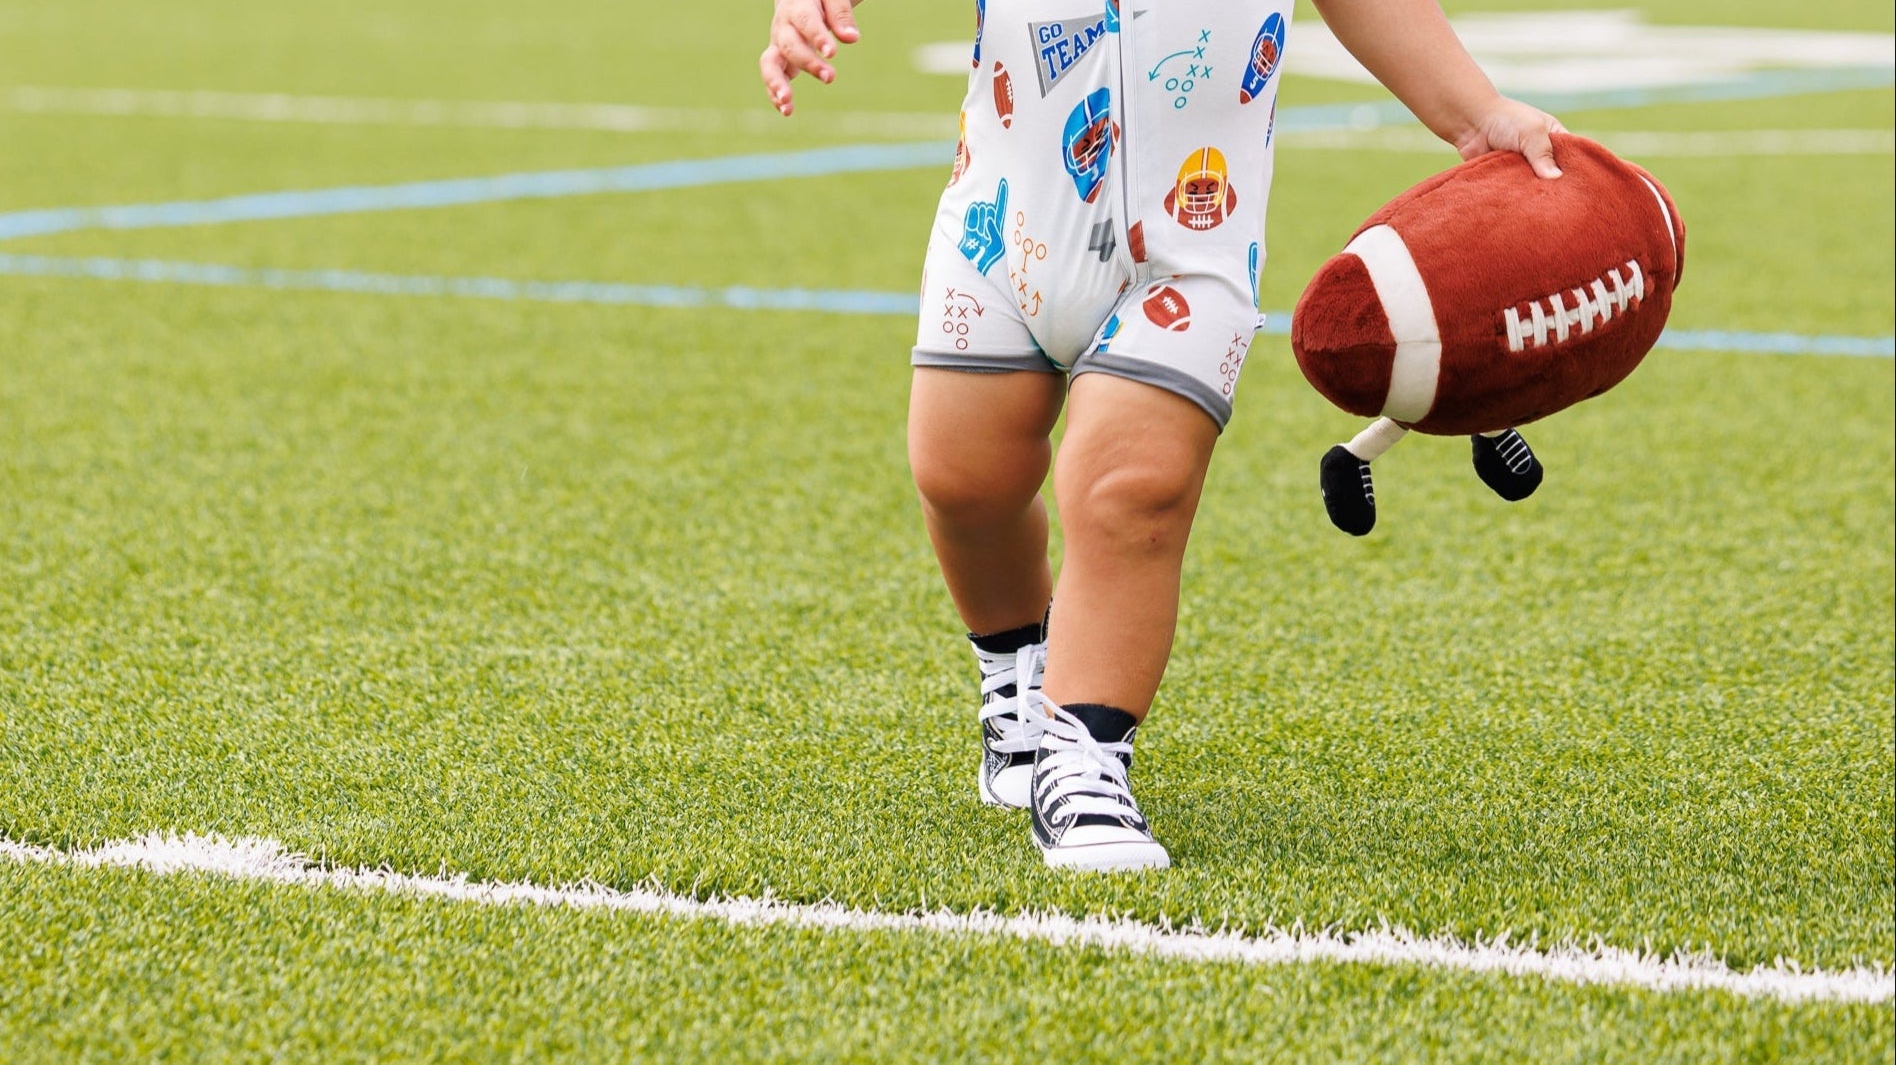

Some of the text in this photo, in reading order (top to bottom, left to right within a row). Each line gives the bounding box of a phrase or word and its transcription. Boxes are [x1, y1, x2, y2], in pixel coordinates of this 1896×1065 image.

[1038, 23, 1063, 44] GO
[1041, 19, 1106, 81] TEAM
[966, 238, 986, 267] #1
